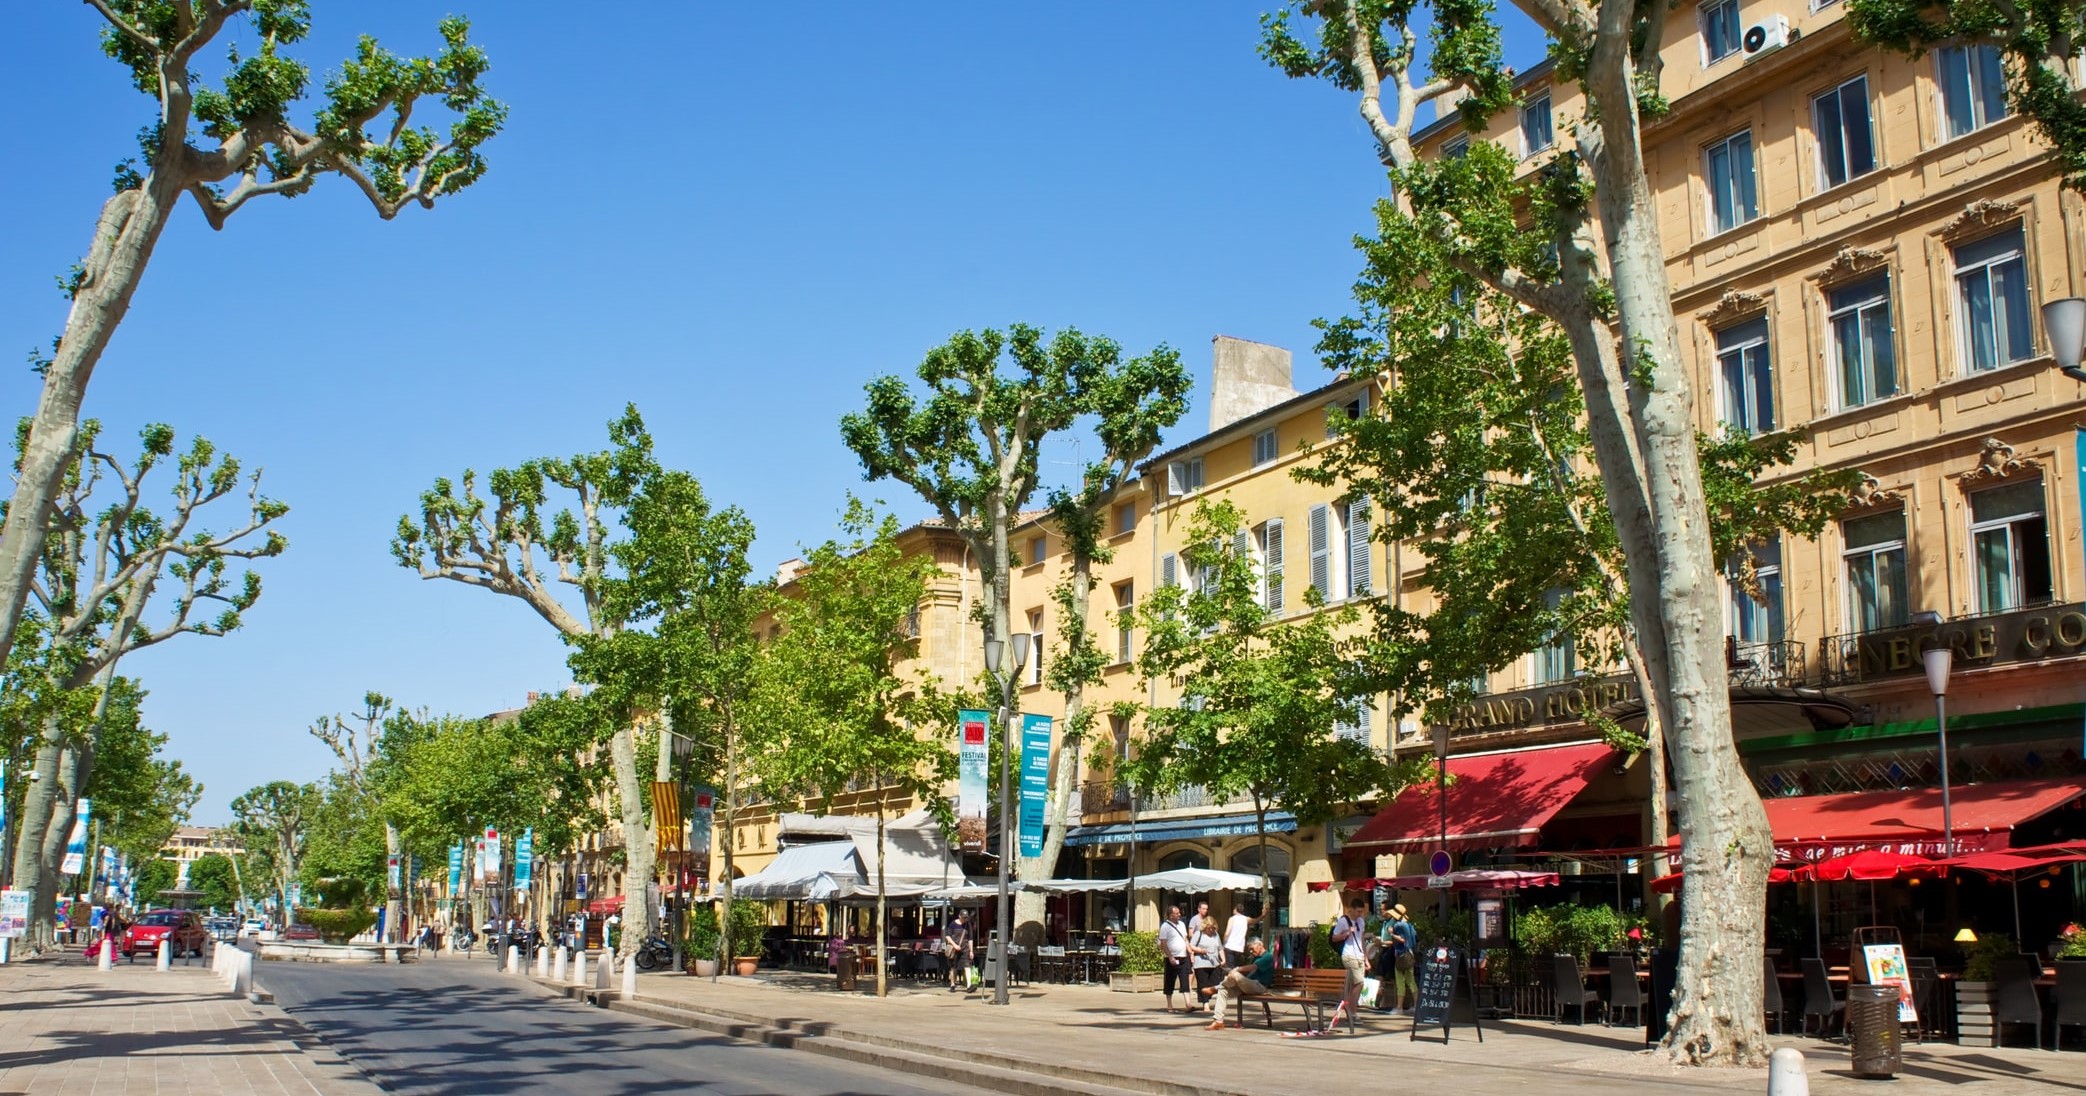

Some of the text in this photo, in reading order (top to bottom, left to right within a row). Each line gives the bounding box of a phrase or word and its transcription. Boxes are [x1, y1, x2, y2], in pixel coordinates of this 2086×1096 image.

[1449, 697, 1534, 731] GRAND
[1203, 826, 1230, 836] LIBRAIRIE
[1233, 825, 1242, 834] DE
[1105, 834, 1112, 843] DE
[1115, 832, 1142, 842] PROVECE
